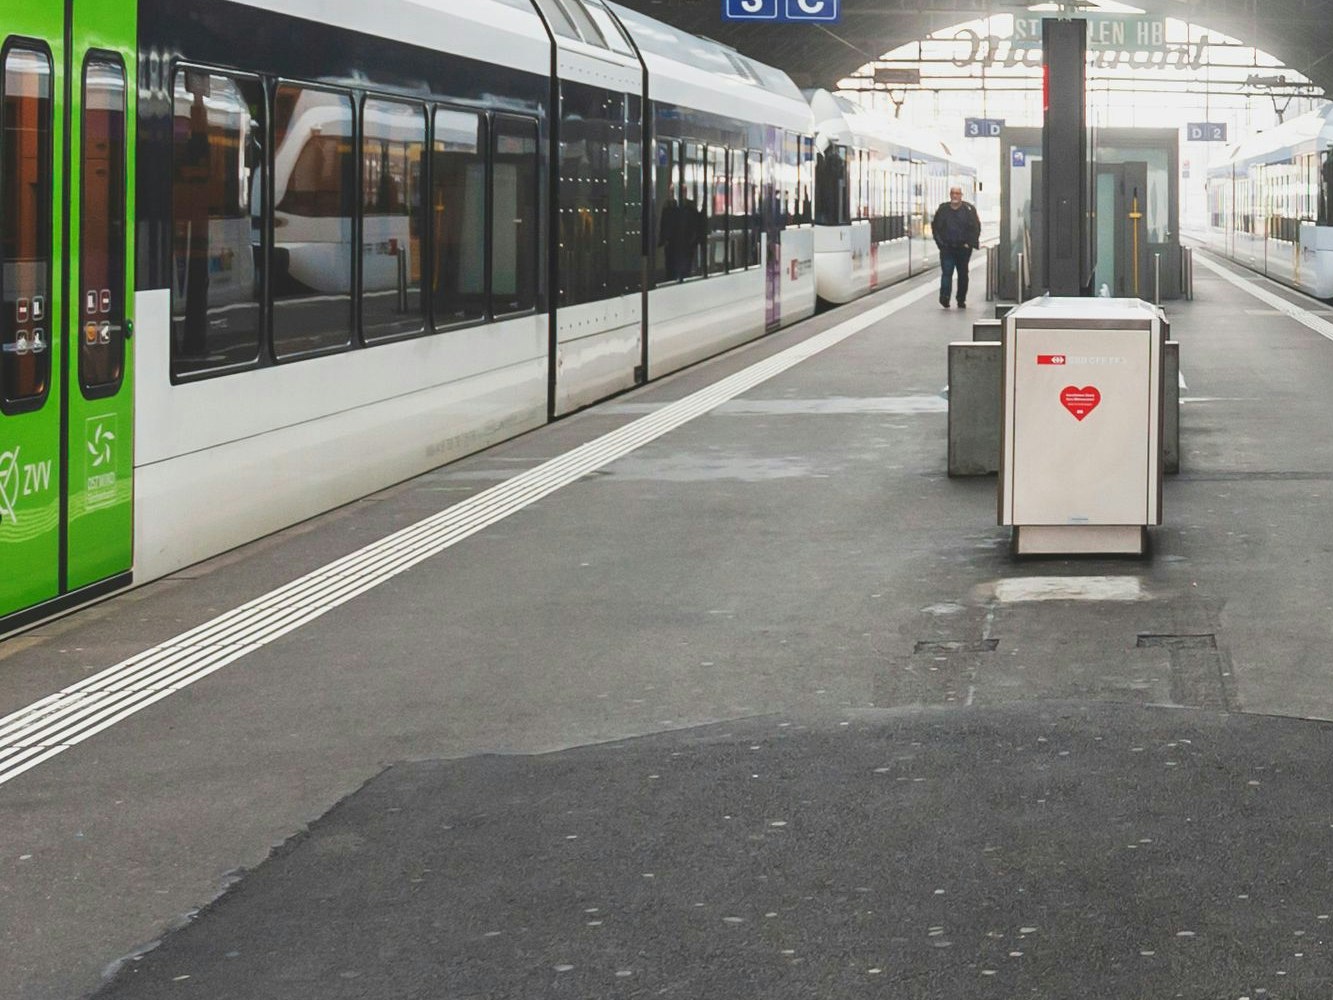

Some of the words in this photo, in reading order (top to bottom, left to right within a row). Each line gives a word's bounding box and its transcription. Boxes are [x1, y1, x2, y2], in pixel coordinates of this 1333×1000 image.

[1137, 21, 1163, 45] HB
[970, 123, 979, 135] 3
[990, 124, 1001, 135] D
[1191, 128, 1202, 139] D
[1213, 128, 1222, 139] 2
[23, 460, 52, 496] ZVV
